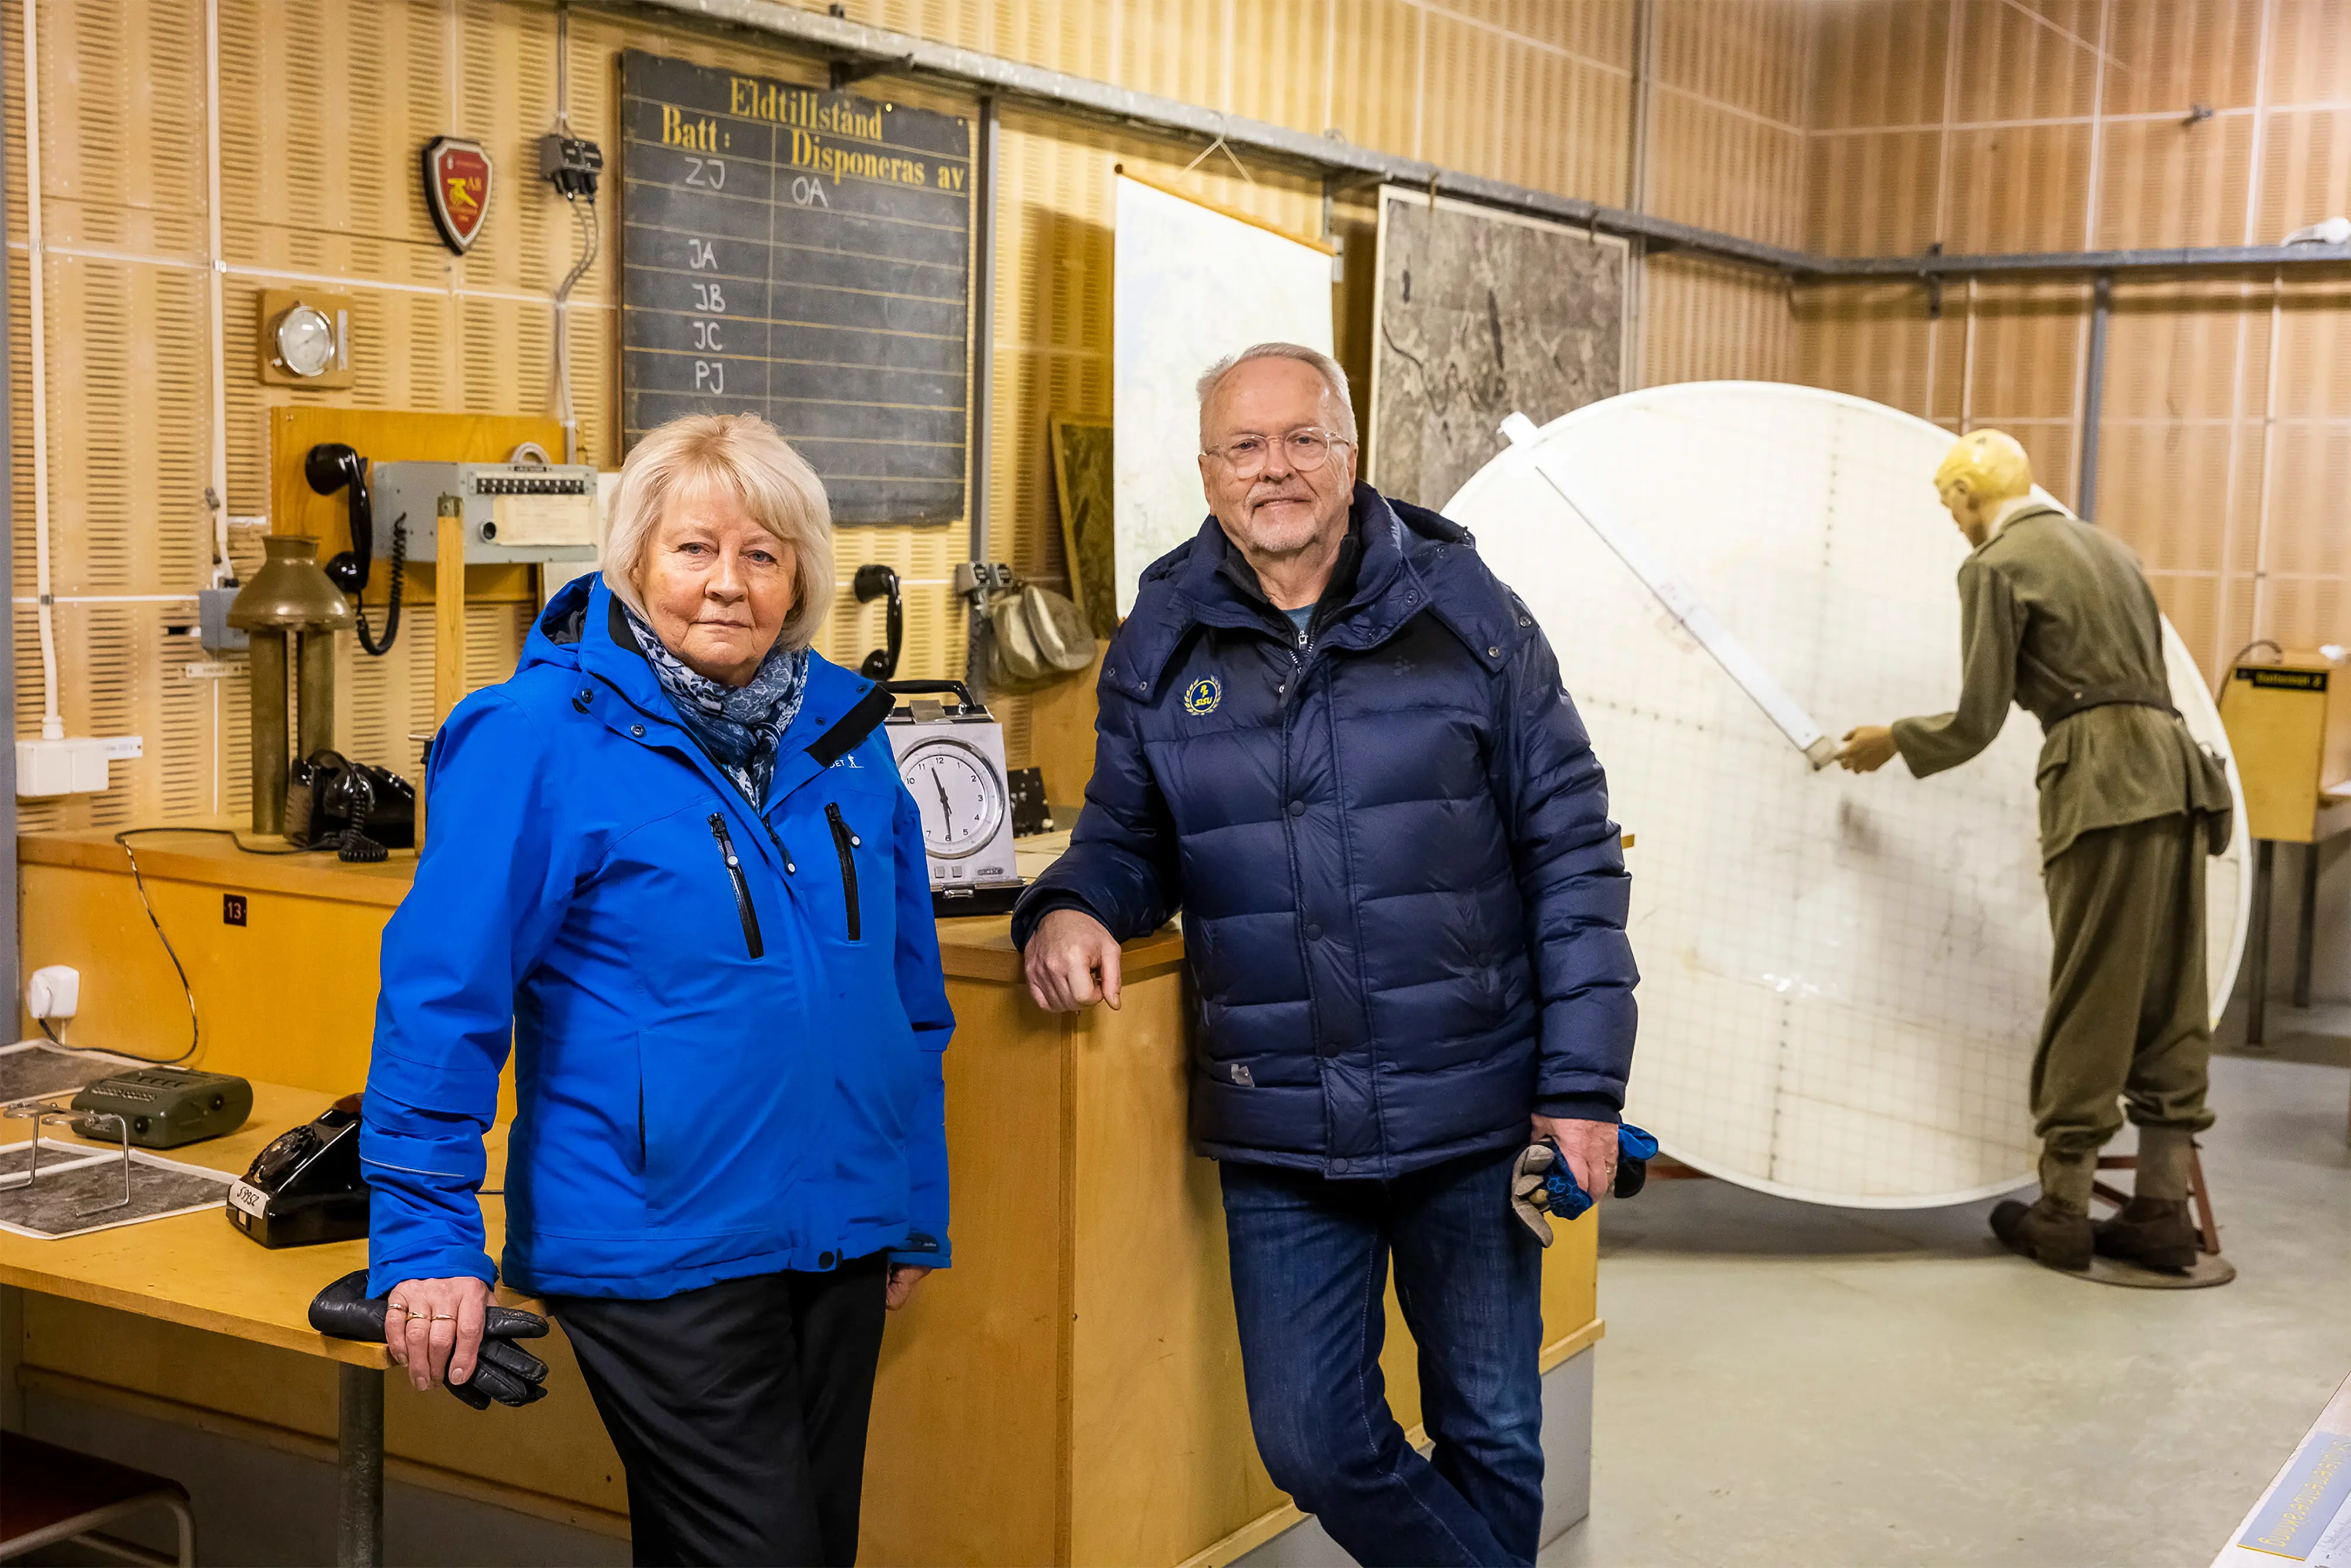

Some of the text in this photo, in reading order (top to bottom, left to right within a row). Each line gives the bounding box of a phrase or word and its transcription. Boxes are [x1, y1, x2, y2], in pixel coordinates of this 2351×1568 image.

[731, 76, 882, 140] Eldtillstånd
[792, 129, 964, 190] Disponeras av
[792, 176, 829, 209] OA
[689, 239, 718, 270] JA
[692, 283, 726, 313] JB
[694, 321, 723, 351] JC
[695, 360, 724, 395] PJ
[1194, 696, 1213, 706] SISU
[227, 901, 242, 919] 13
